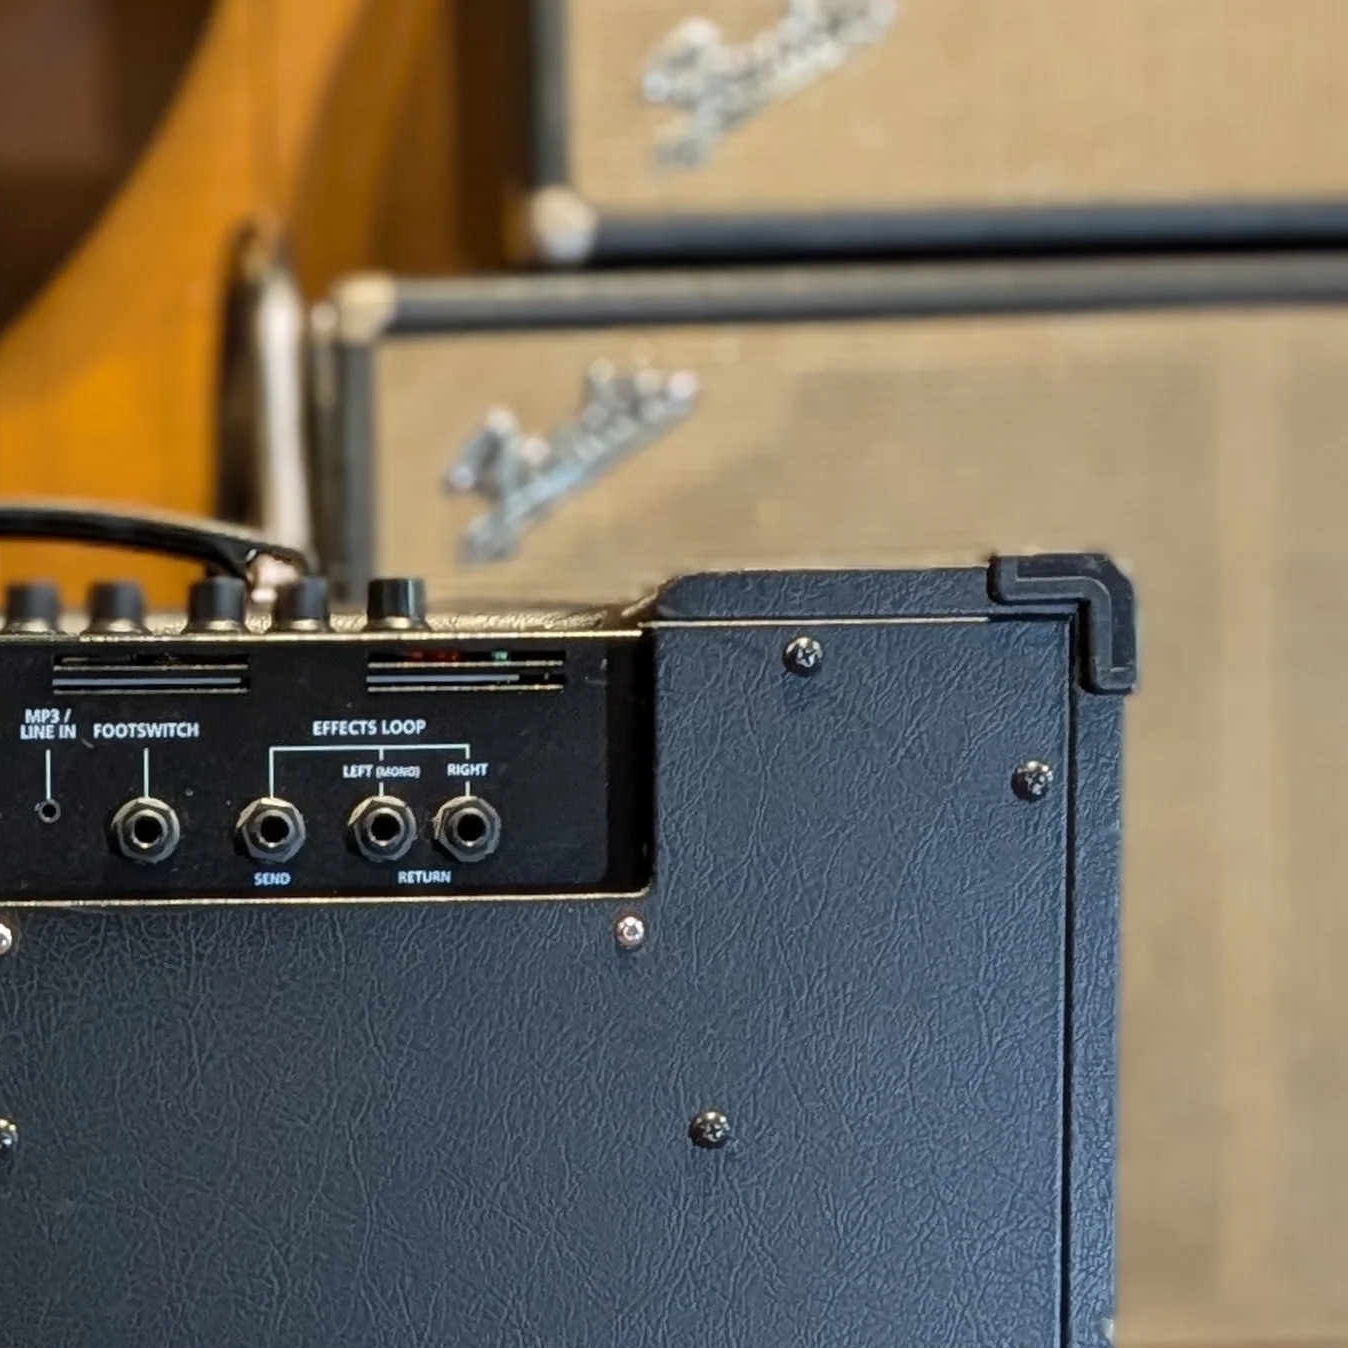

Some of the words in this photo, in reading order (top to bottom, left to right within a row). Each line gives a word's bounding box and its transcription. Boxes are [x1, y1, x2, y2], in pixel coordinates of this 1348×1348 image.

[25, 708, 61, 724] MP3
[20, 725, 55, 740] LINE
[58, 725, 77, 739] IN
[93, 722, 200, 739] FOOTSWITCH
[312, 720, 377, 736] EFFECTS
[381, 720, 427, 735] LOOP
[343, 764, 373, 778] LEFT
[447, 763, 489, 776] RIGHT
[254, 872, 291, 886] SEND
[398, 870, 451, 884] RETURN
